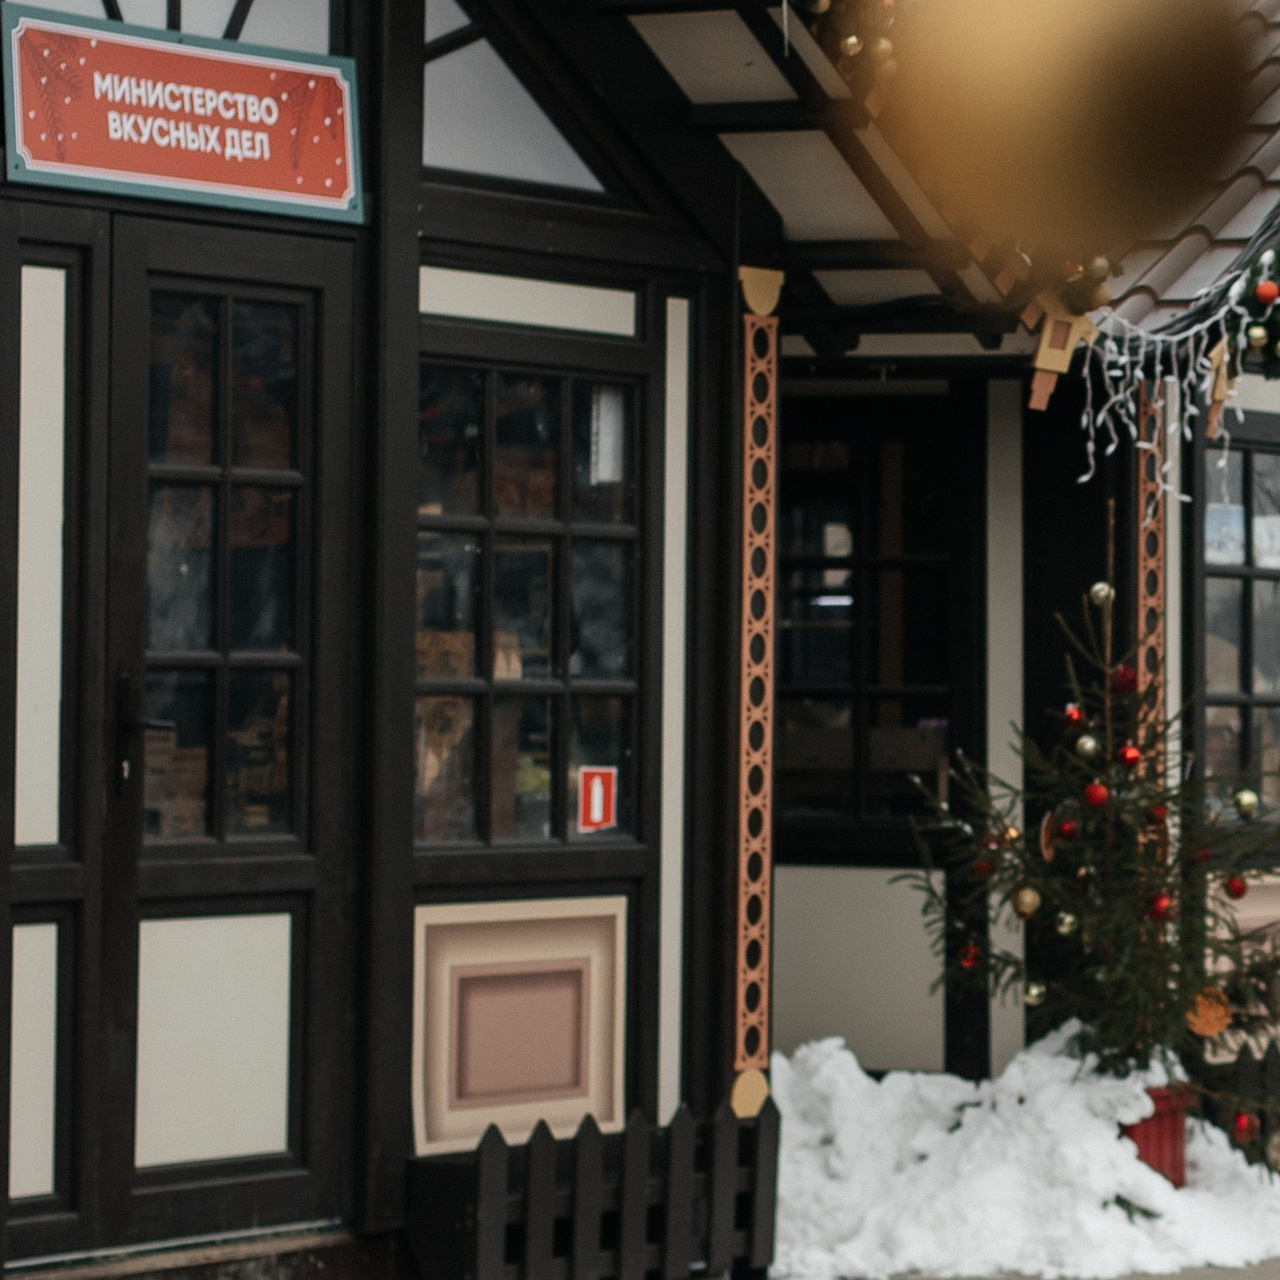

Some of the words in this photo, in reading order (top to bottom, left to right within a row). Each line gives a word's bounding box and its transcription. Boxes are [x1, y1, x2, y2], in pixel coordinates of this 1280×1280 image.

[93, 71, 279, 126] МИНИСТЕРСТВО
[107, 110, 222, 154] ВКУСНЫХ
[224, 127, 271, 162] ДЕЛ
